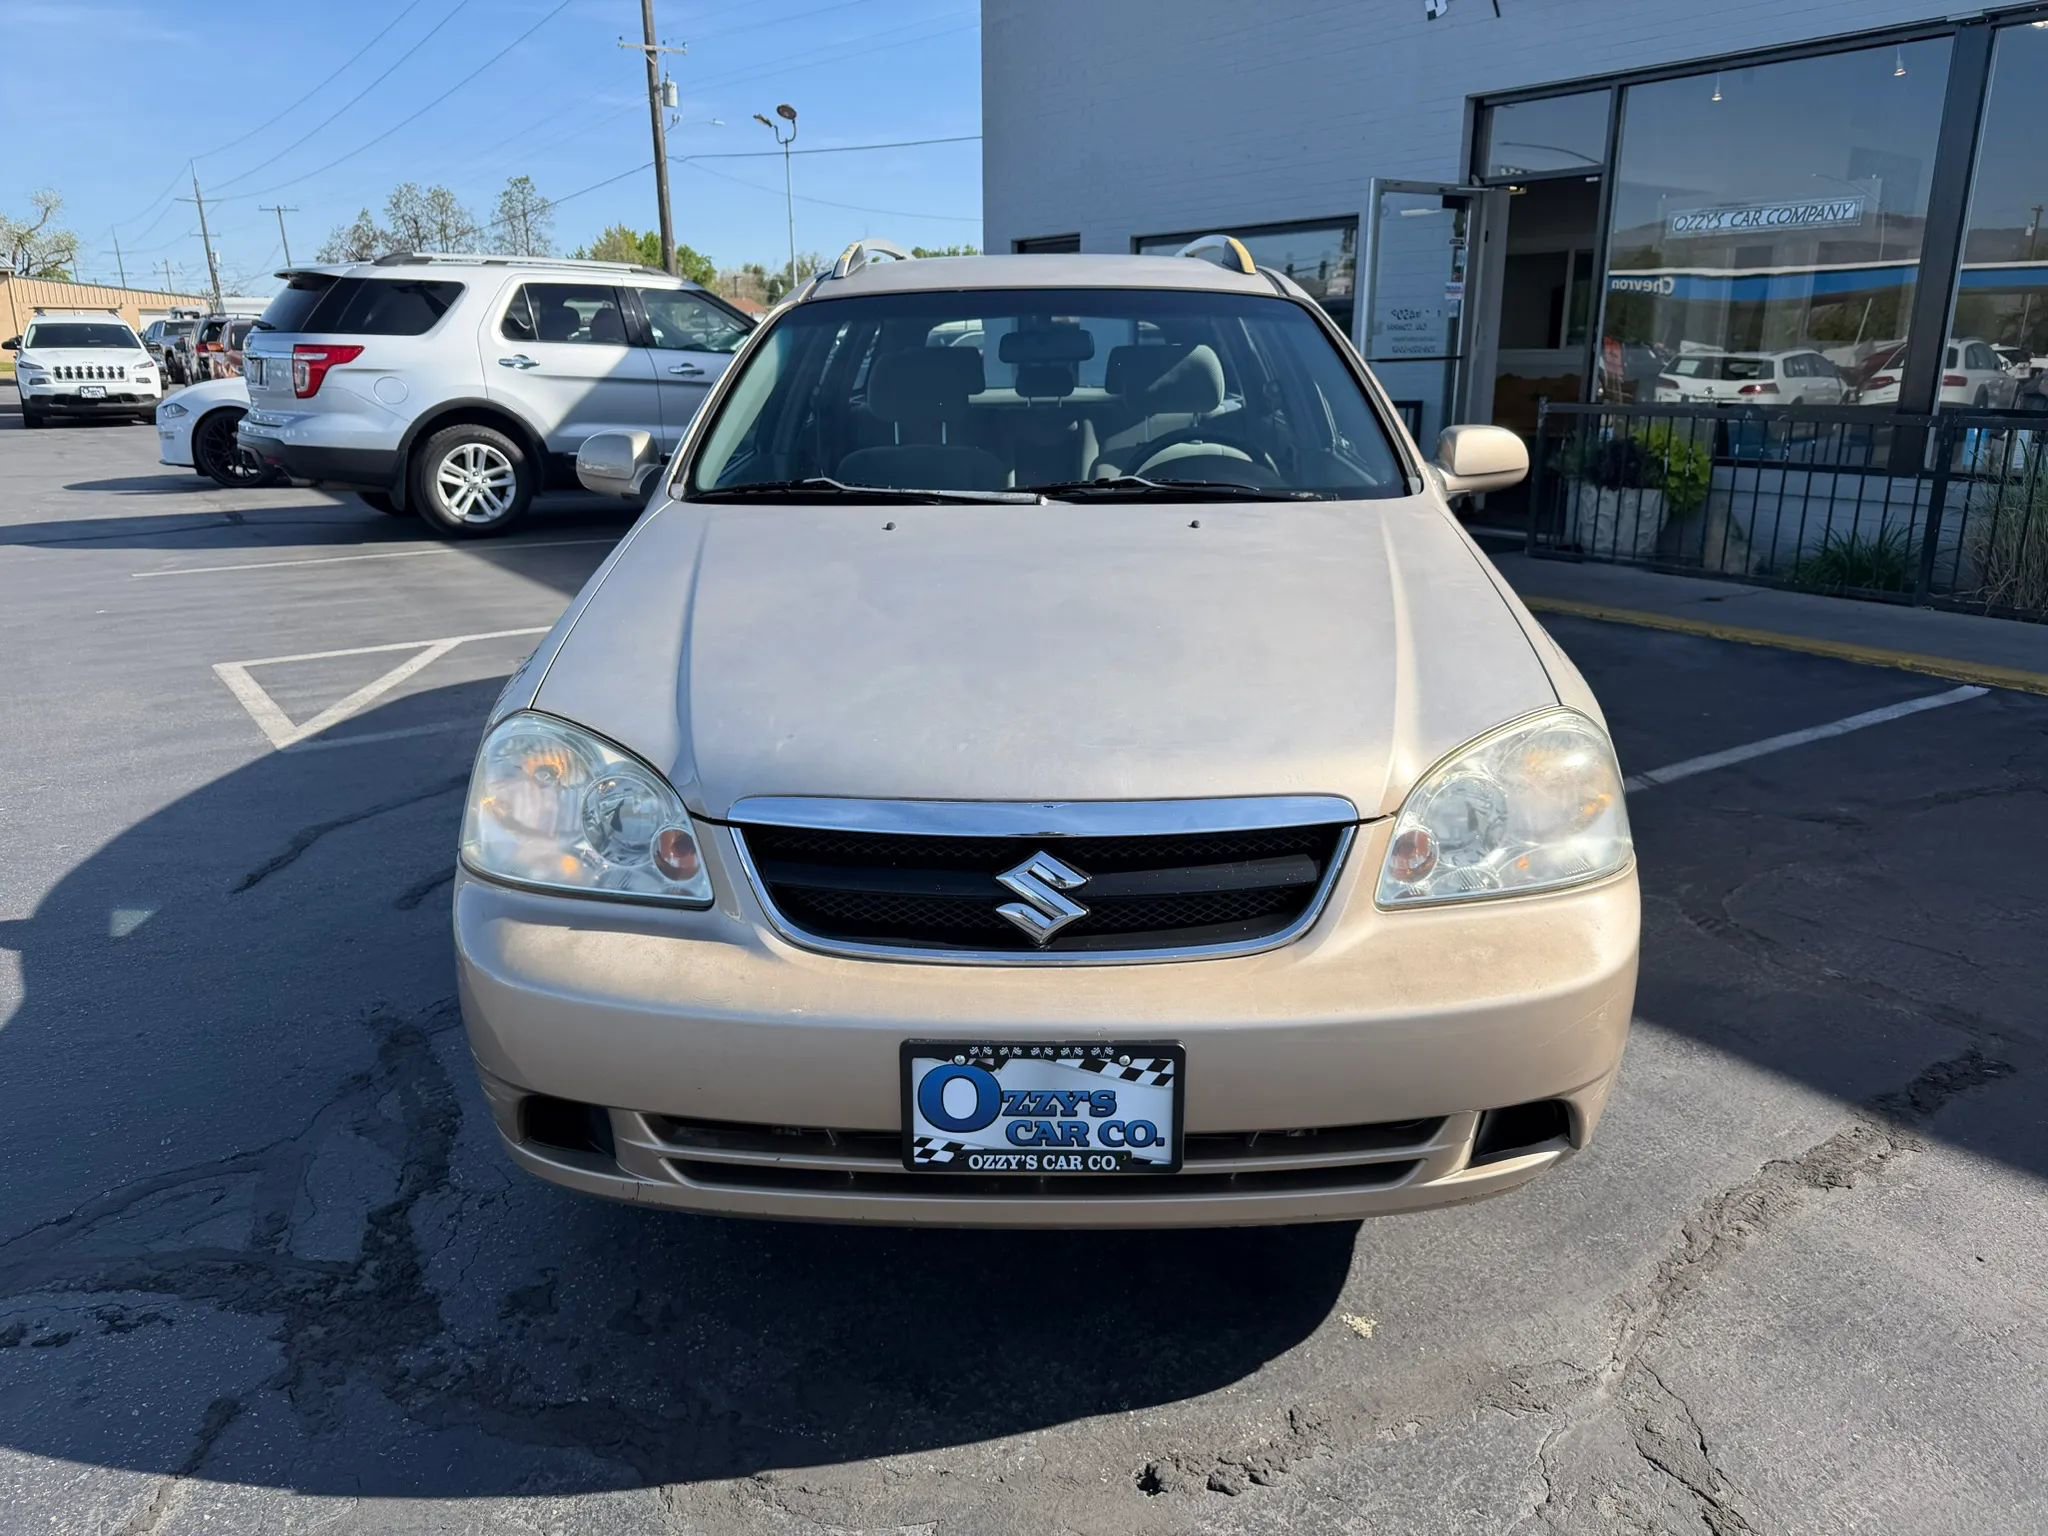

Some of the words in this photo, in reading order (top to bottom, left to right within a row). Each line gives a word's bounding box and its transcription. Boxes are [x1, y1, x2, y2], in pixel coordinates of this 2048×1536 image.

[1674, 214, 1725, 231] OZZY'S
[1731, 210, 1762, 227] CAR
[1767, 203, 1852, 224] COMPANY
[1005, 1120, 1089, 1146] CAR
[1097, 1119, 1165, 1147] CO.
[968, 1154, 1038, 1171] OZZY'S
[1043, 1154, 1083, 1171] CAR
[1088, 1154, 1120, 1171] CO.
